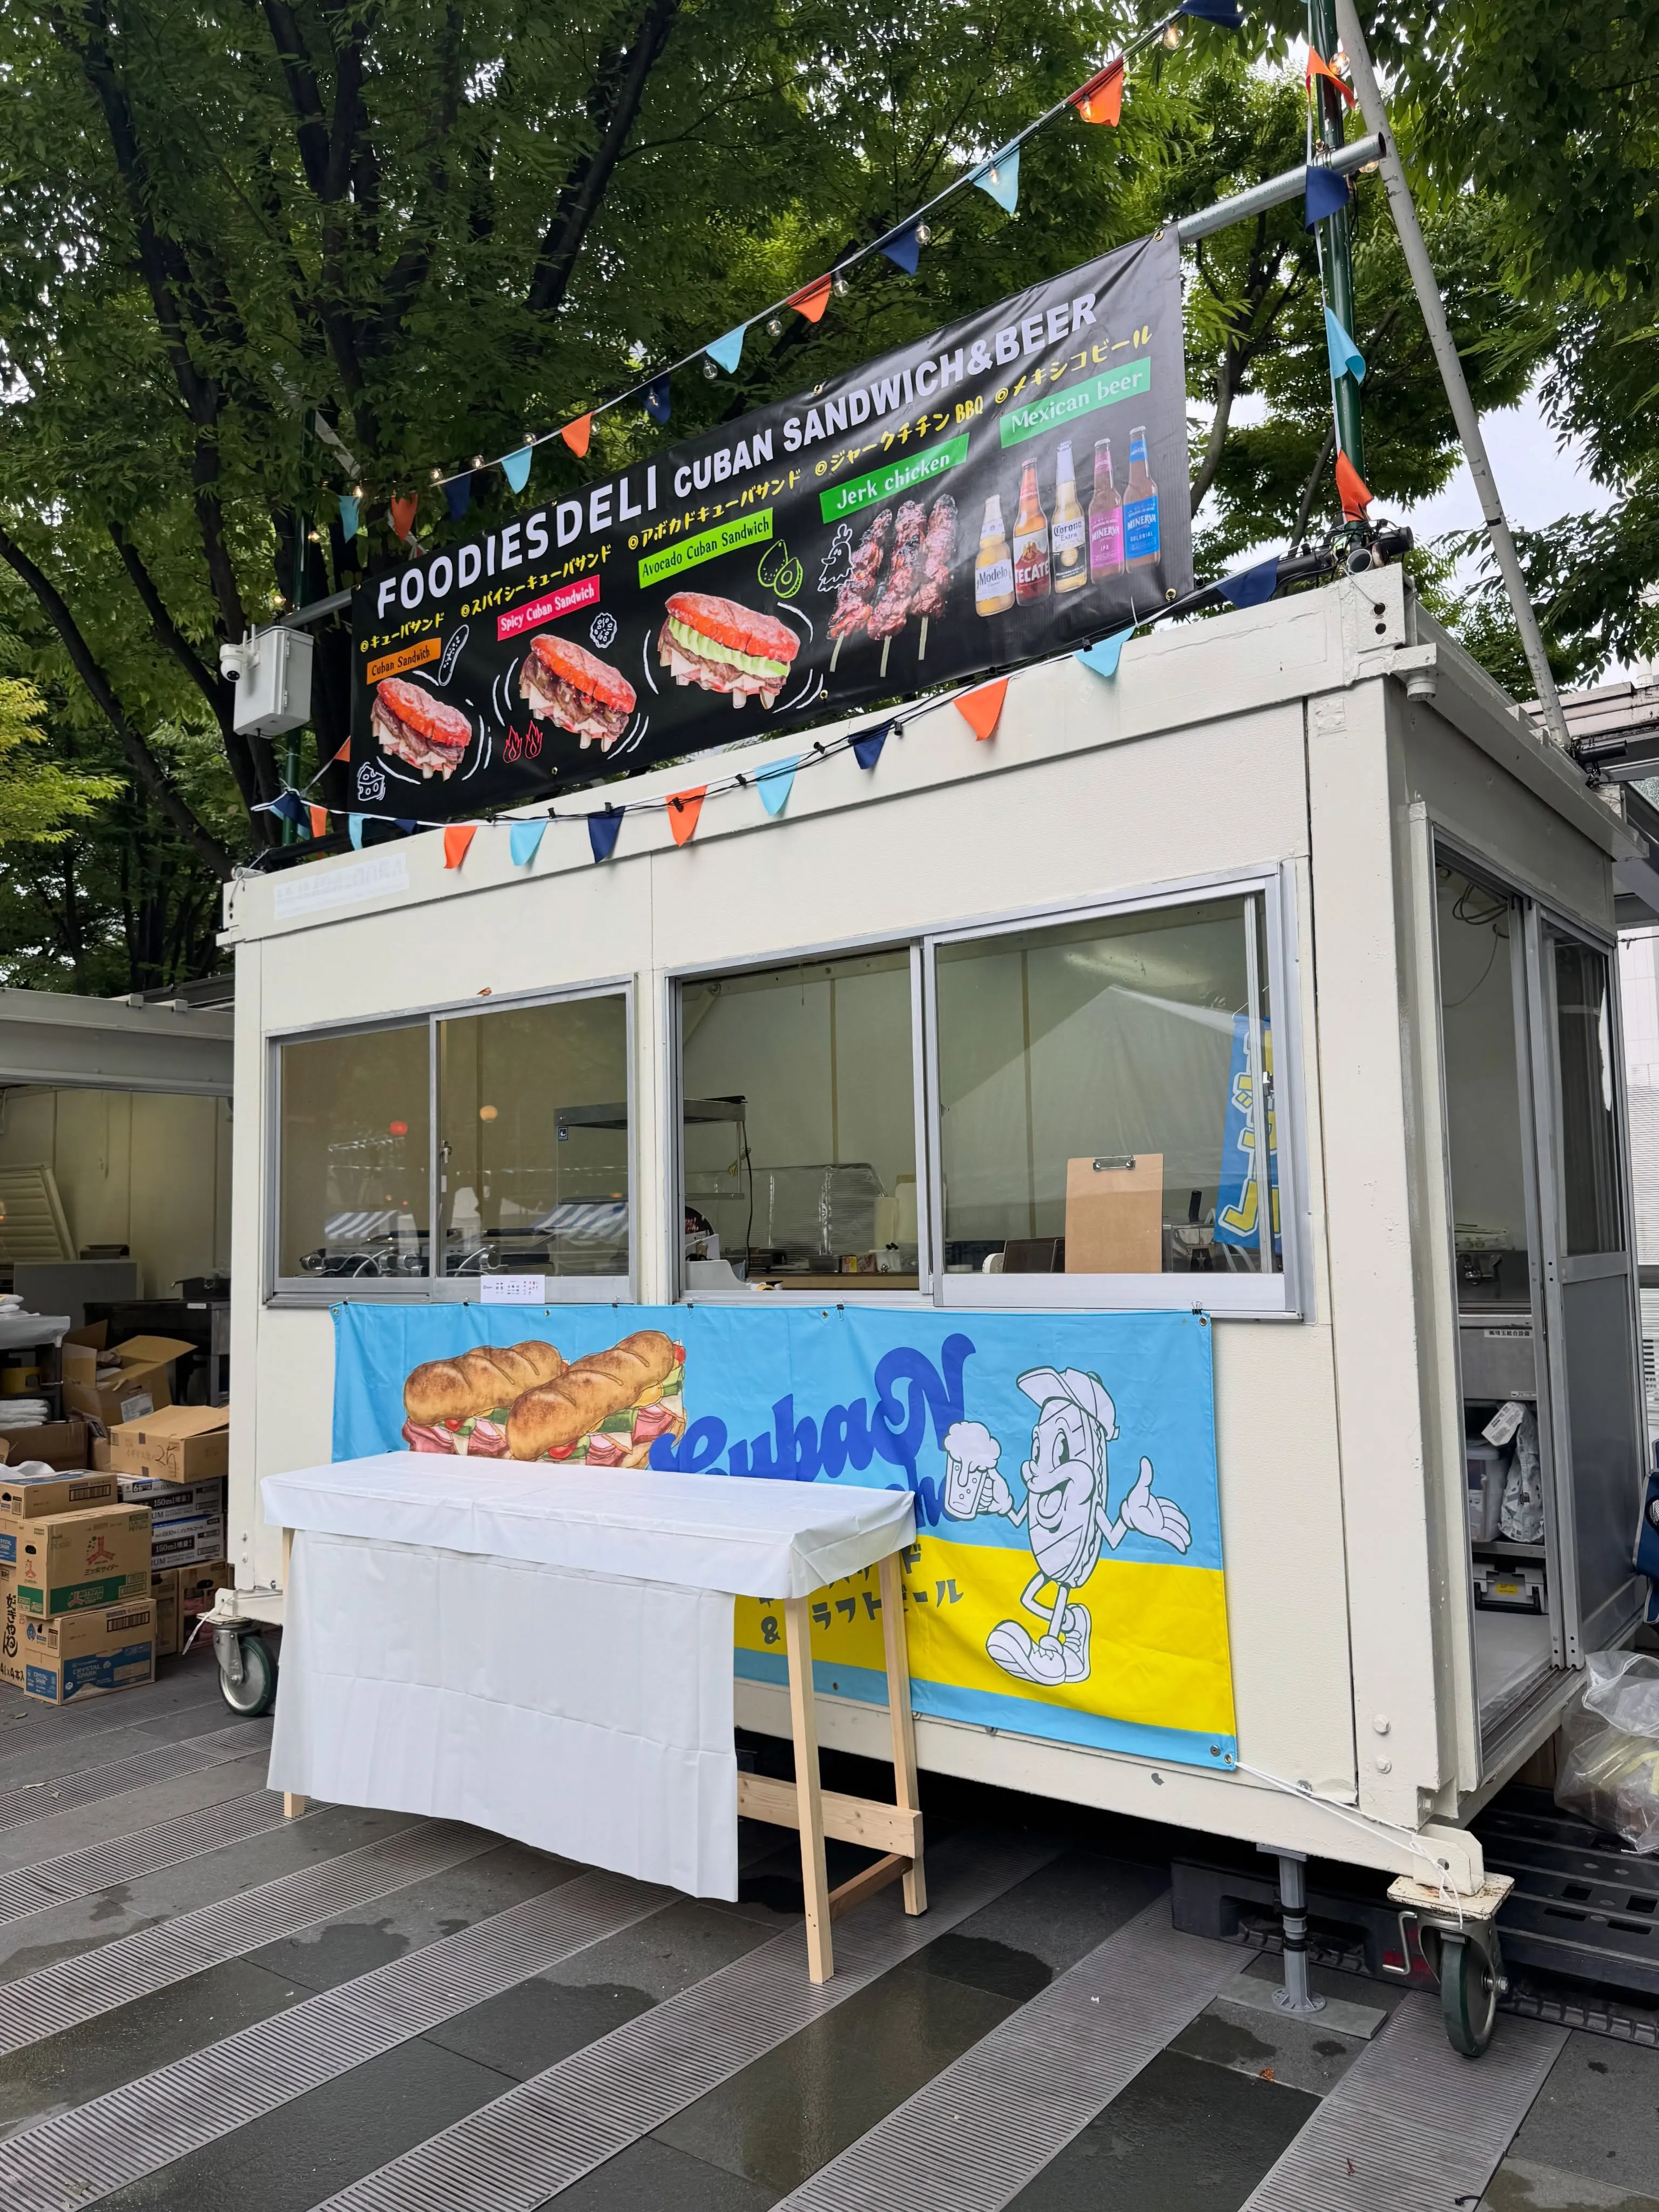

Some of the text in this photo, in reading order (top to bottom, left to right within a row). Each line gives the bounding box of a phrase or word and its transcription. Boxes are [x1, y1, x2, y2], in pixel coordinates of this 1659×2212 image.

[673, 429, 773, 498] CUBAN
[782, 292, 1097, 452] SANDWICH&BEER
[1011, 371, 1143, 434] Mexican beer
[955, 395, 984, 425] BBQ
[837, 454, 950, 509] Jerk chicken
[1054, 521, 1082, 536] Corona
[1127, 513, 1156, 529] MINERVA
[1060, 532, 1077, 541] Extra
[1091, 527, 1120, 541] MINERVA
[1130, 531, 1154, 542] COLONIAL
[642, 516, 770, 578] Avocado Cuban Sandwich
[979, 567, 1008, 583] Modelo
[1015, 561, 1050, 584] TECATE
[500, 583, 595, 632] Spicy Cuban Sandwich
[372, 646, 430, 677] Cuban Sandwich
[72, 1663, 102, 1675] CRYSTAL
[76, 1670, 98, 1680] SPARK
